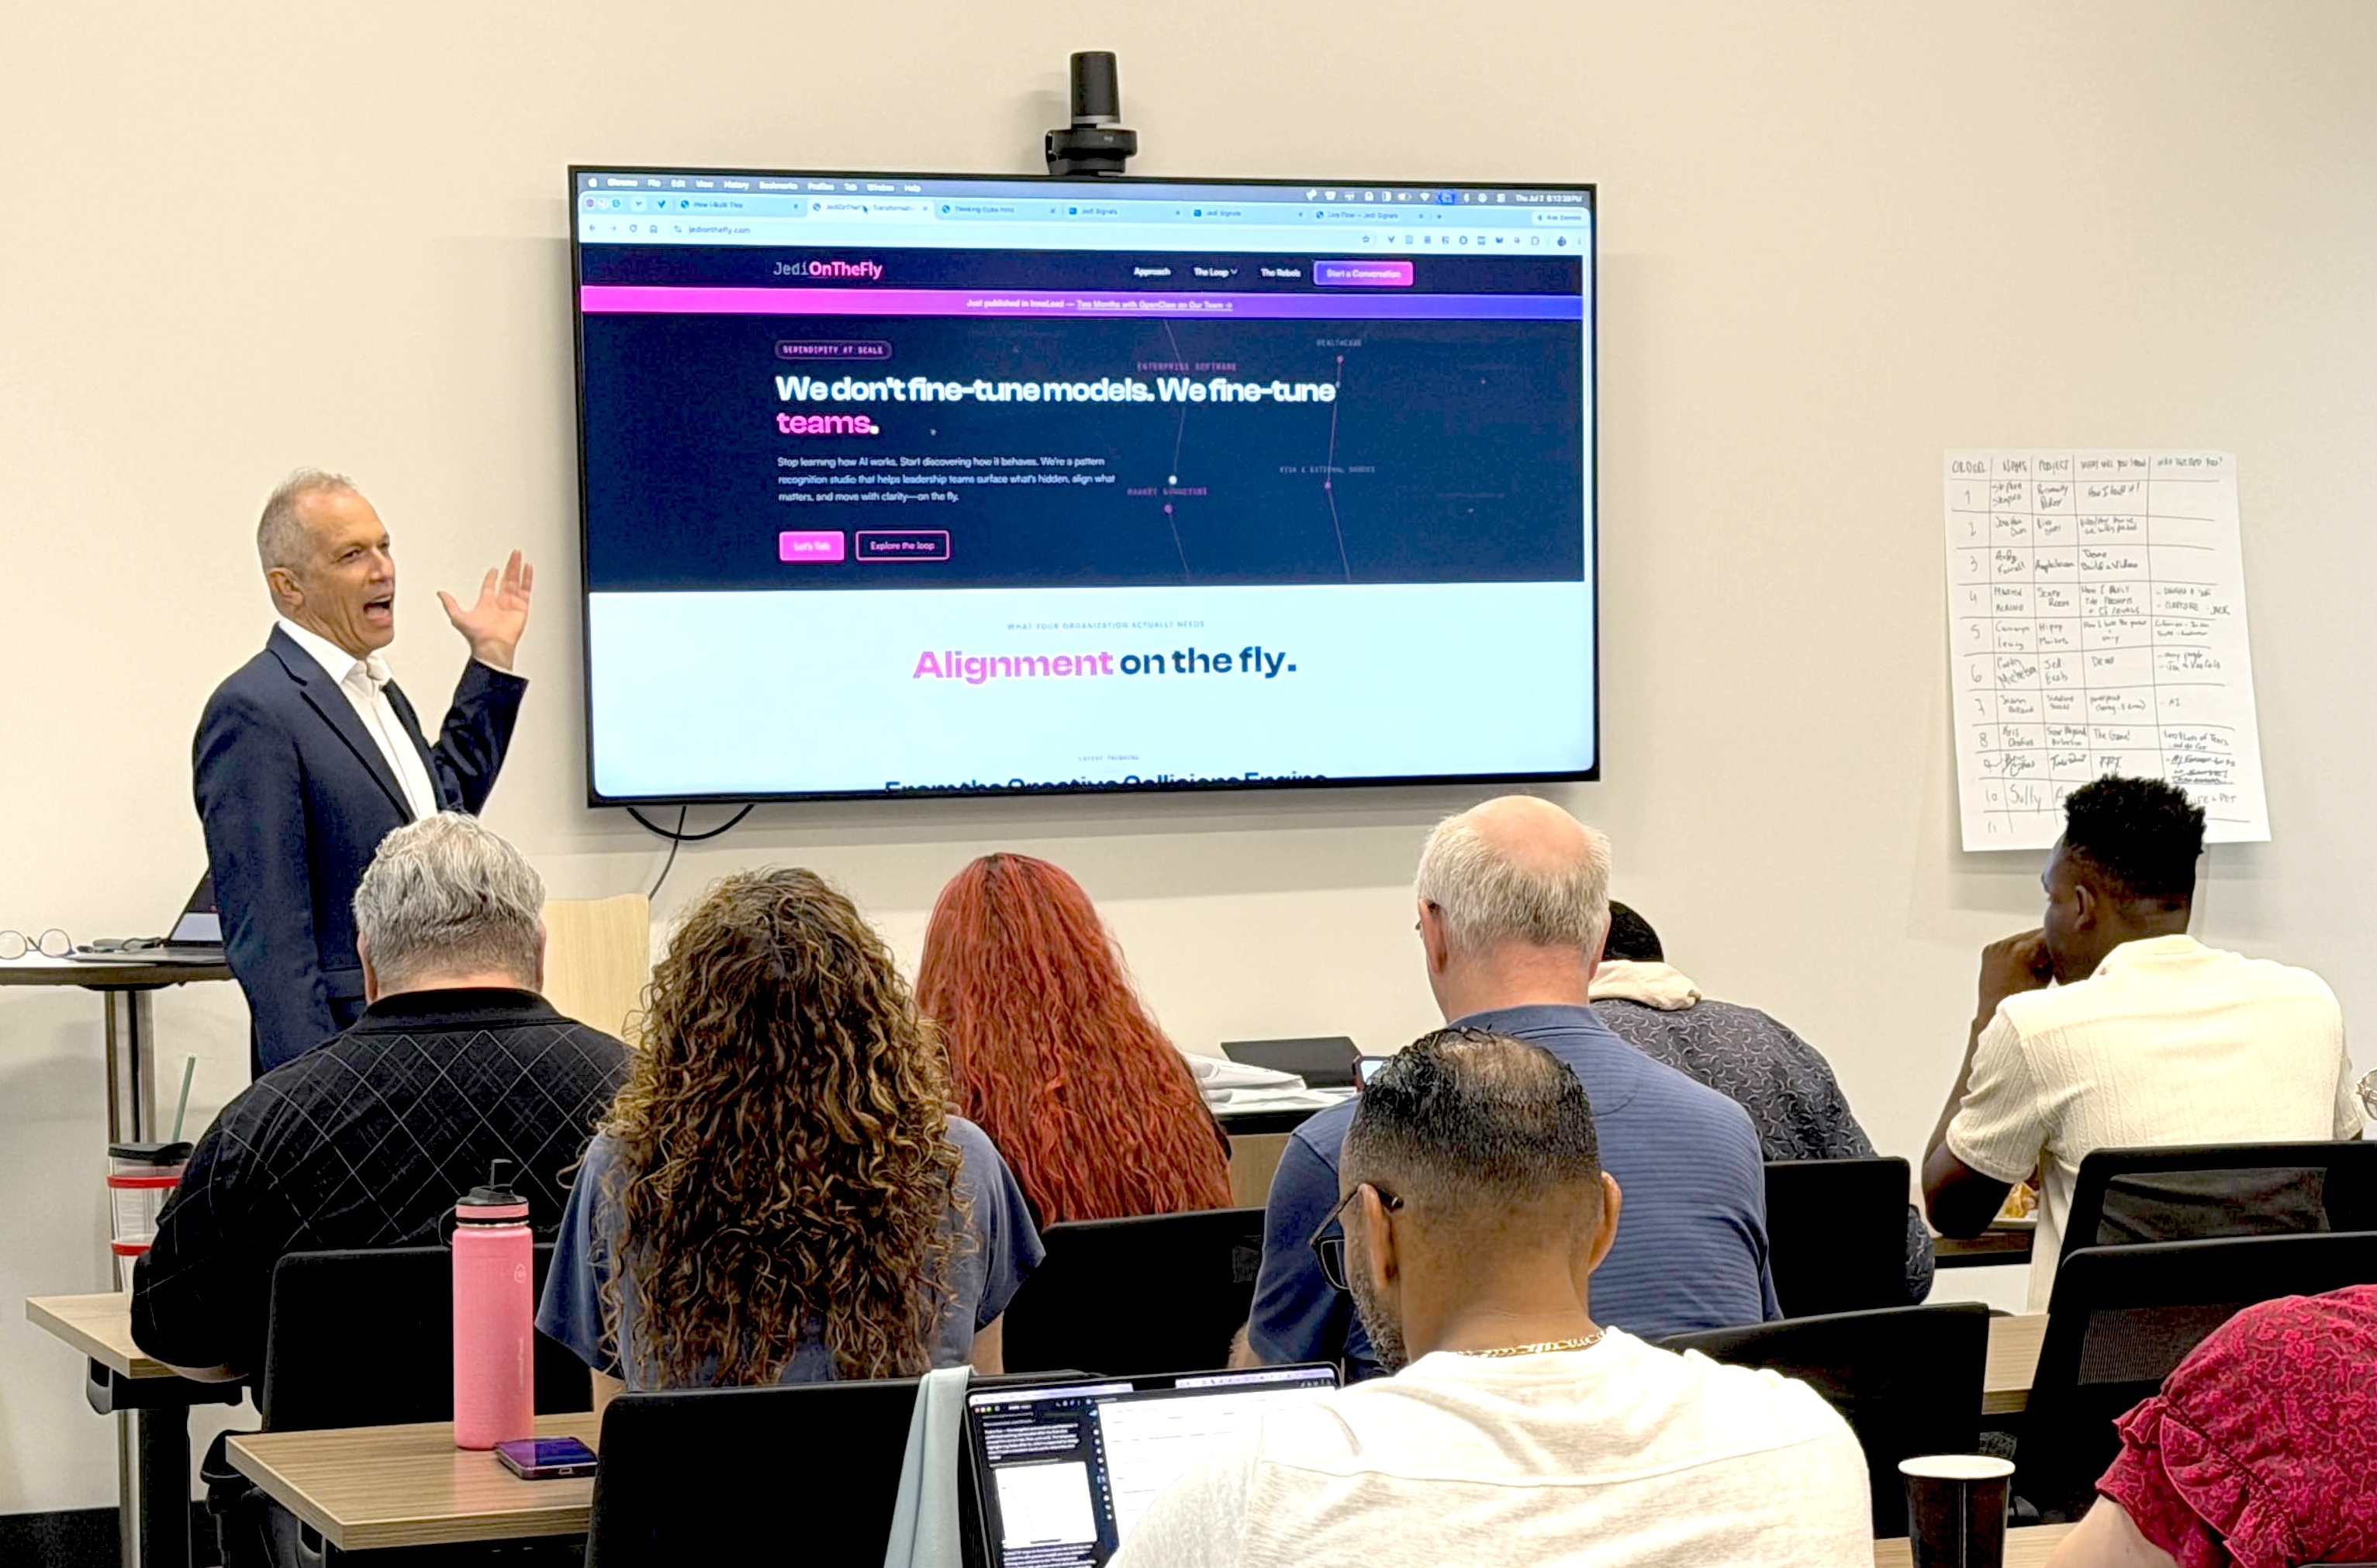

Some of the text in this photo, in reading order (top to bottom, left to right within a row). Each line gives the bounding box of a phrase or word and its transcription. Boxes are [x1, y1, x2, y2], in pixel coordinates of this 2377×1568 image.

[648, 179, 662, 188] File
[671, 179, 686, 188] Edit
[696, 180, 713, 188] View
[724, 181, 749, 190] History
[773, 261, 883, 280] JediOnTheFly
[1134, 267, 1171, 277] Approach
[1193, 268, 1207, 277] The
[1260, 268, 1275, 277] The
[783, 345, 883, 354] SERENDIPITY AT SCALE
[776, 375, 1335, 402] We don't fine-tune models. We fine-tune
[776, 413, 879, 435] teams.
[777, 457, 799, 468] Stop
[800, 457, 836, 468] learning
[838, 457, 857, 466] how
[859, 457, 869, 466] AI
[869, 457, 898, 467] works.
[900, 457, 921, 467] Start
[922, 456, 971, 468] discovering
[973, 457, 992, 466] how
[993, 456, 1000, 466] it
[1000, 457, 1038, 467] behaves.
[1040, 456, 1065, 466] We're
[1074, 457, 1105, 468] pattern
[778, 475, 828, 486] recognition
[830, 474, 857, 484] studio
[858, 475, 875, 484] that
[876, 475, 900, 485] helps
[902, 475, 947, 486] leadership
[948, 475, 975, 484] teams
[976, 474, 1008, 484] surface
[1072, 474, 1093, 486] align
[1094, 475, 1115, 484] what
[816, 491, 833, 502] and
[835, 493, 859, 502] move
[861, 492, 879, 502] with
[931, 492, 945, 502] the
[869, 541, 935, 551] Explore the loop
[1970, 556, 1978, 572] 3
[1971, 624, 1981, 639] 5
[913, 646, 1297, 685] Alignment on the fly.
[1971, 664, 1982, 682] 6
[1978, 732, 1988, 748] 8
[2009, 783, 2042, 814] Sully
